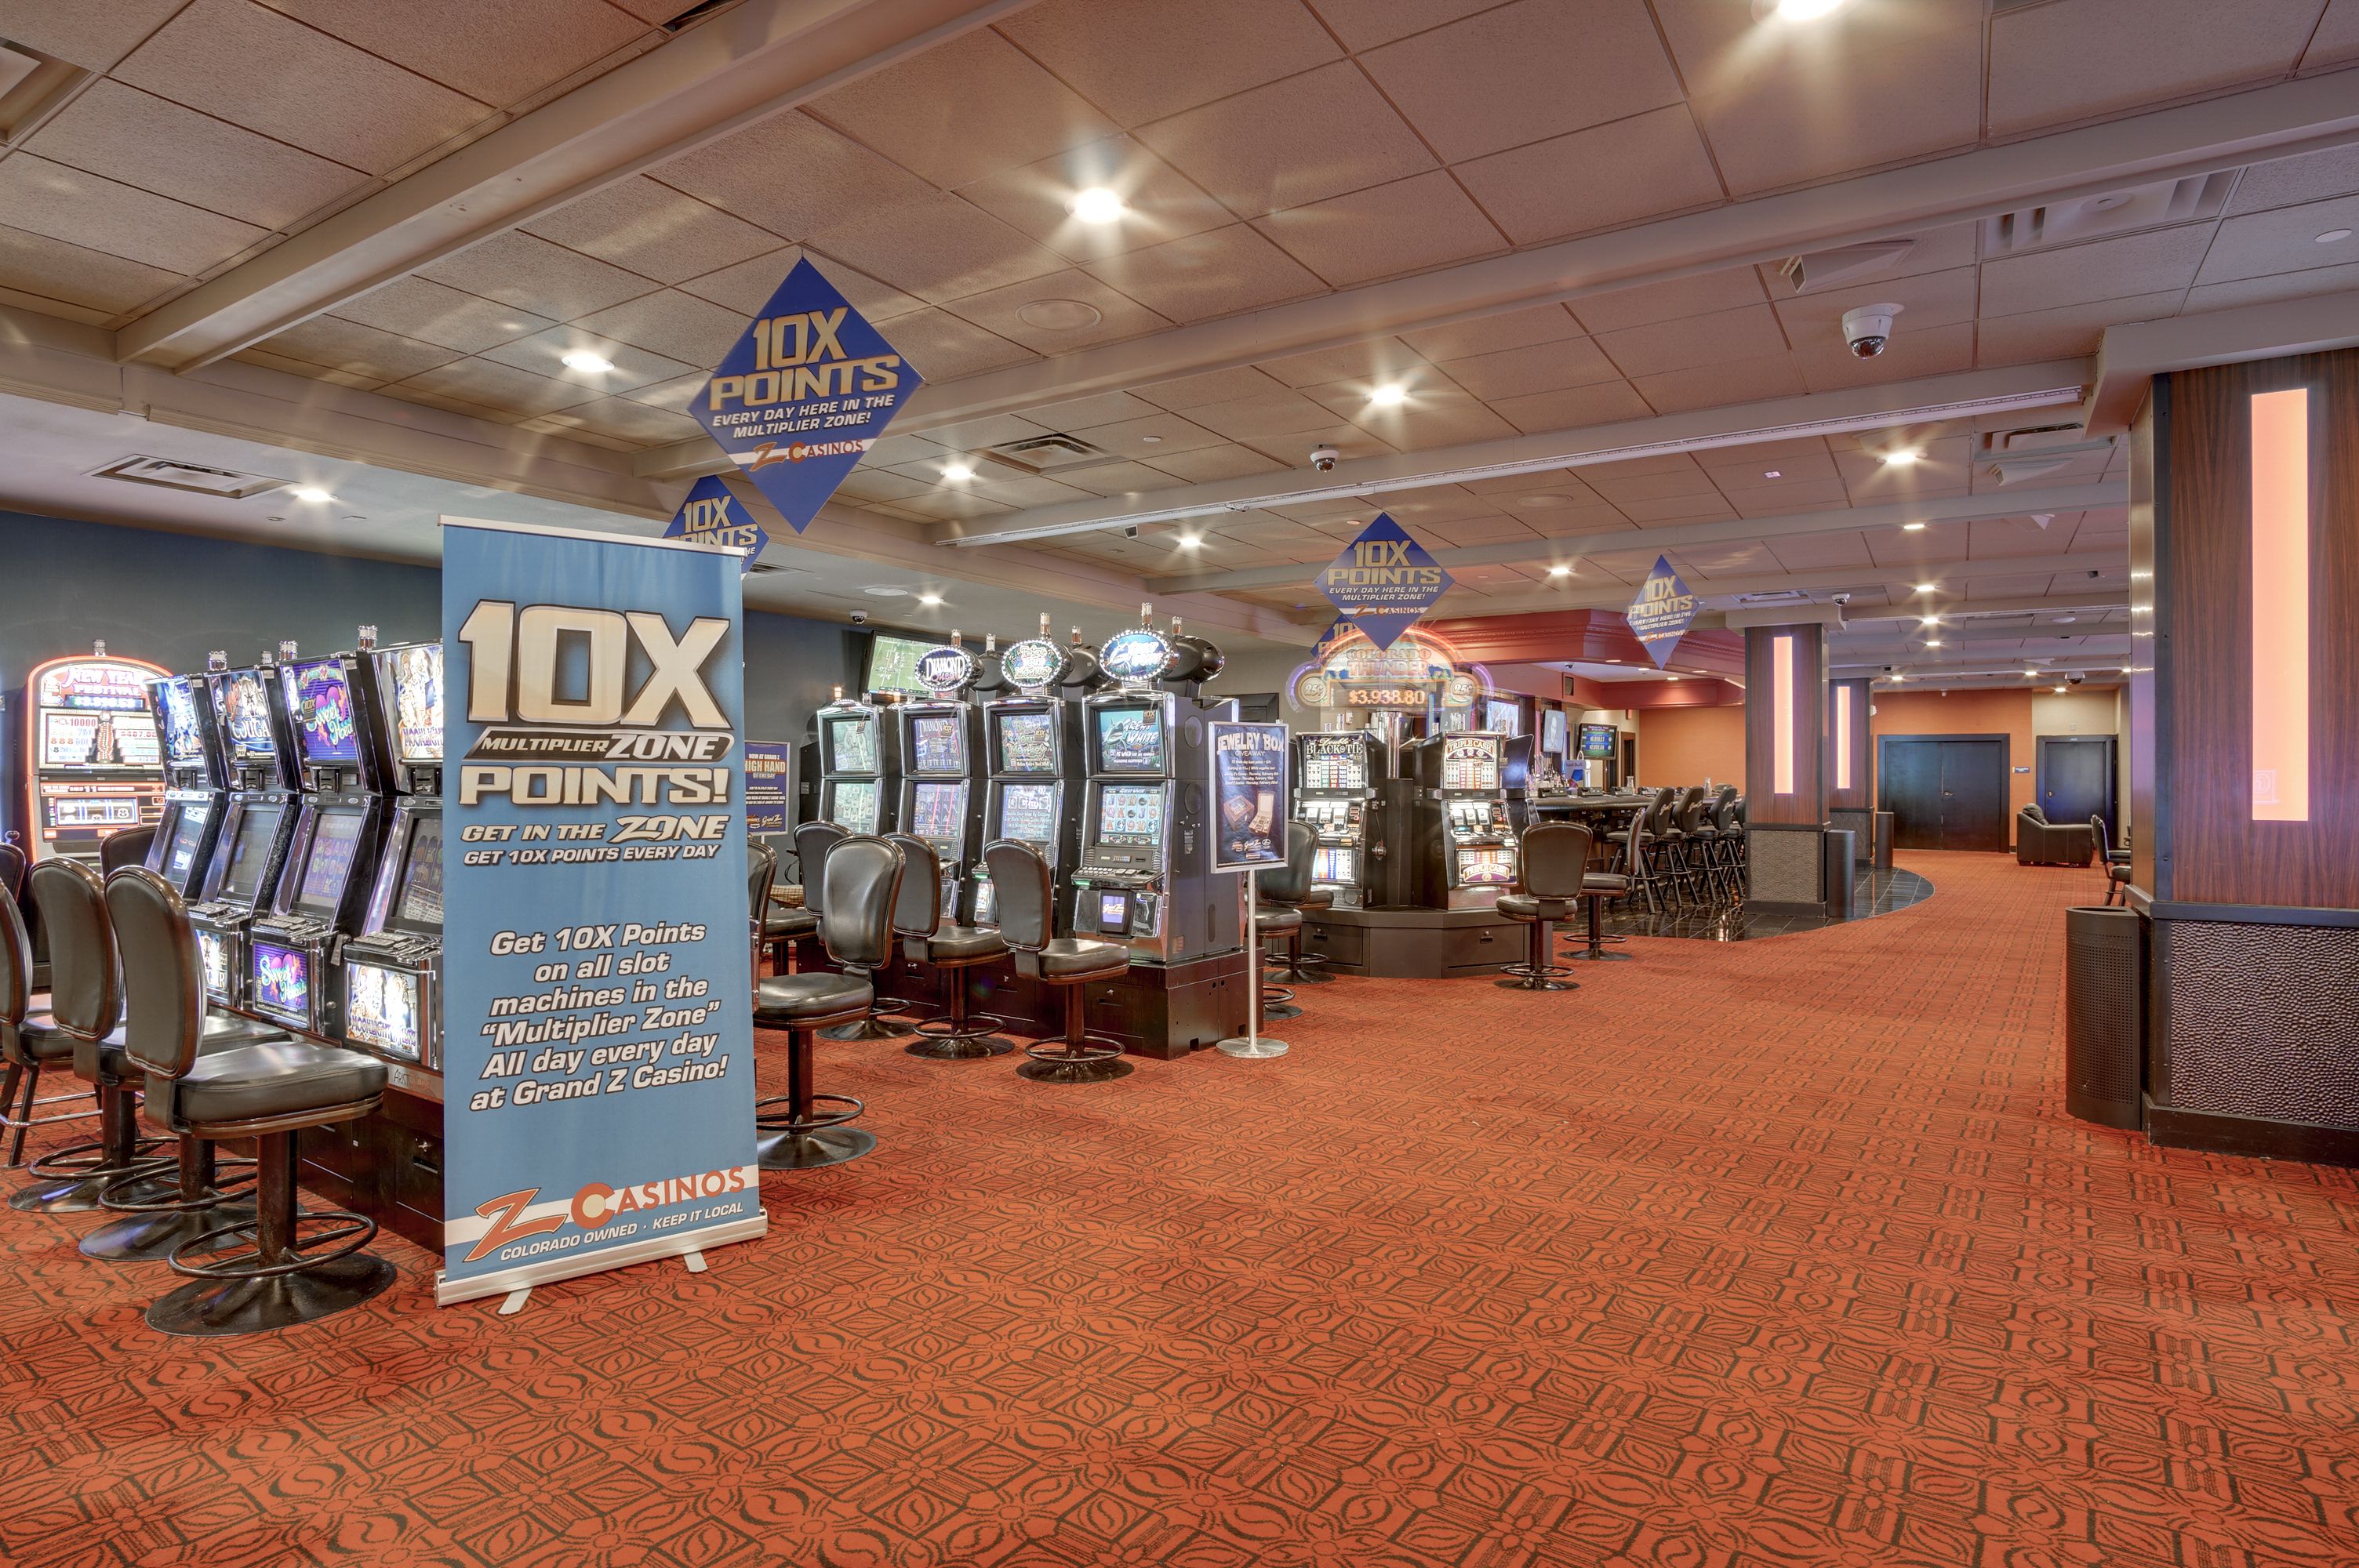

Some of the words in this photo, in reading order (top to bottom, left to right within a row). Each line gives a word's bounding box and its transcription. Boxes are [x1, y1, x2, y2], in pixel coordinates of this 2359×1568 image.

[752, 307, 849, 371] 10X
[709, 354, 900, 411] POINTS
[712, 411, 761, 427] EVERY
[763, 407, 796, 422] DAY
[799, 401, 839, 418] HERE
[842, 398, 861, 412] IN
[865, 394, 896, 408] THE
[733, 418, 820, 438] MULTIPLIER
[824, 412, 871, 428] ZONE!
[749, 442, 787, 472] Z
[788, 439, 863, 464] CASINOS
[683, 495, 732, 533] 10X
[667, 524, 758, 546] INTS
[1354, 539, 1411, 567] 10X
[1327, 567, 1441, 586] POINTS
[1645, 575, 1676, 602] 10X
[1627, 595, 1693, 619] POINTS
[1333, 622, 1355, 641] 10
[459, 599, 734, 730] 10X
[1347, 648, 1432, 659] COLORADO
[925, 656, 965, 681] DIAMOND
[1347, 660, 1429, 678] THUNDER
[232, 720, 271, 739] COUGA
[1126, 731, 1158, 744] WHITE
[1216, 731, 1260, 755] JEWELRY
[1263, 733, 1284, 752] BOX
[1318, 737, 1349, 746] Double
[482, 737, 609, 753] MULTIPLIER
[605, 733, 720, 760] ZONE
[1307, 744, 1340, 753] BLACK
[1346, 745, 1362, 753] TIE
[1448, 739, 1473, 753] TRIPLE
[1474, 739, 1492, 753] CASH
[764, 760, 786, 773] HAND
[458, 765, 730, 804] POINTS!
[461, 825, 518, 842] GET
[521, 825, 551, 841] IN
[556, 823, 606, 840] THE
[607, 815, 731, 844] ZONE
[463, 850, 504, 866] GET
[508, 849, 547, 864] 10X
[551, 848, 620, 862] POINTS
[623, 845, 679, 861] EVERY
[682, 844, 721, 859] DAY
[490, 931, 547, 956] Get
[554, 924, 620, 952] 10X
[620, 921, 707, 947] Points
[260, 955, 292, 986] Sweet
[535, 962, 569, 982] on
[576, 953, 613, 979] all
[617, 951, 671, 976] slot
[489, 985, 626, 1017] machines
[631, 980, 657, 1004] in
[664, 976, 708, 1000] the
[481, 1012, 636, 1047] “Multiplier
[641, 1000, 721, 1031] Zone”
[479, 1050, 528, 1080] All
[531, 1047, 586, 1075] day
[591, 1040, 666, 1065] every
[671, 1032, 719, 1058] day
[470, 1087, 507, 1111] at
[512, 1071, 602, 1105] Grand
[605, 1068, 628, 1094] Z
[632, 1054, 729, 1090] Casino!
[463, 1187, 568, 1262] Z
[571, 1166, 746, 1230] CASINOS
[500, 1234, 581, 1261] COLORADO
[583, 1223, 638, 1244] OWNED
[652, 1213, 688, 1230] KEEP
[689, 1210, 702, 1223] IT
[704, 1202, 743, 1220] LOCAL
